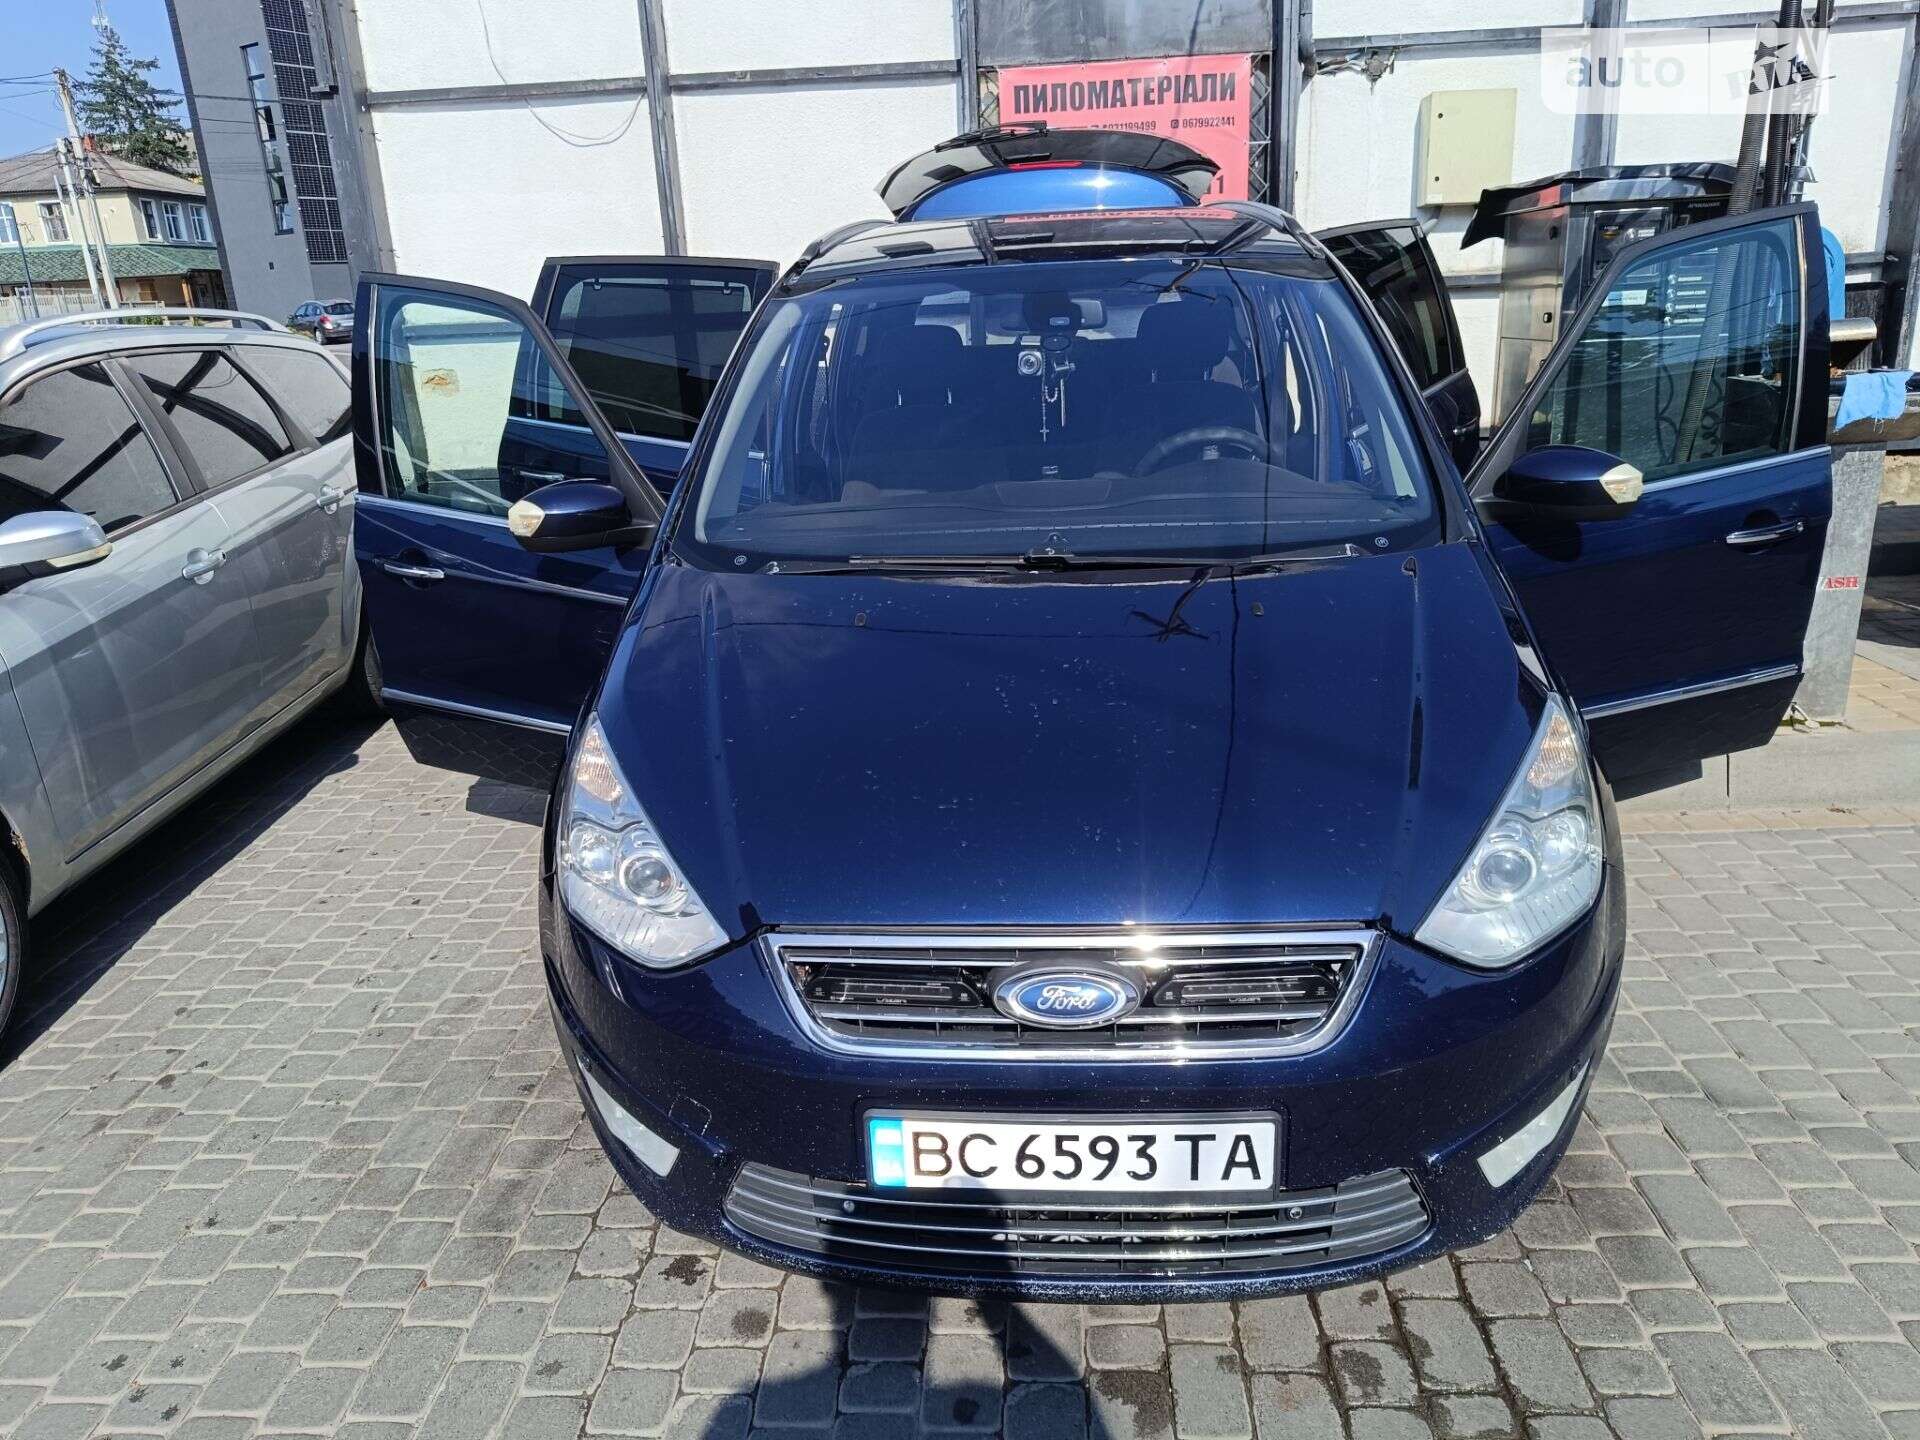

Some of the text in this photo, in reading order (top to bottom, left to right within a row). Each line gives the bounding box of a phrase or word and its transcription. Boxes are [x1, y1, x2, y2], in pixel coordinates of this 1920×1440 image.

[1013, 72, 1237, 114] ПИЛОМАТЕРІАЛИ
[1823, 576, 1859, 589] ASH
[1036, 985, 1100, 1010] Ford
[912, 1131, 1262, 1181] BC 6593 TA
